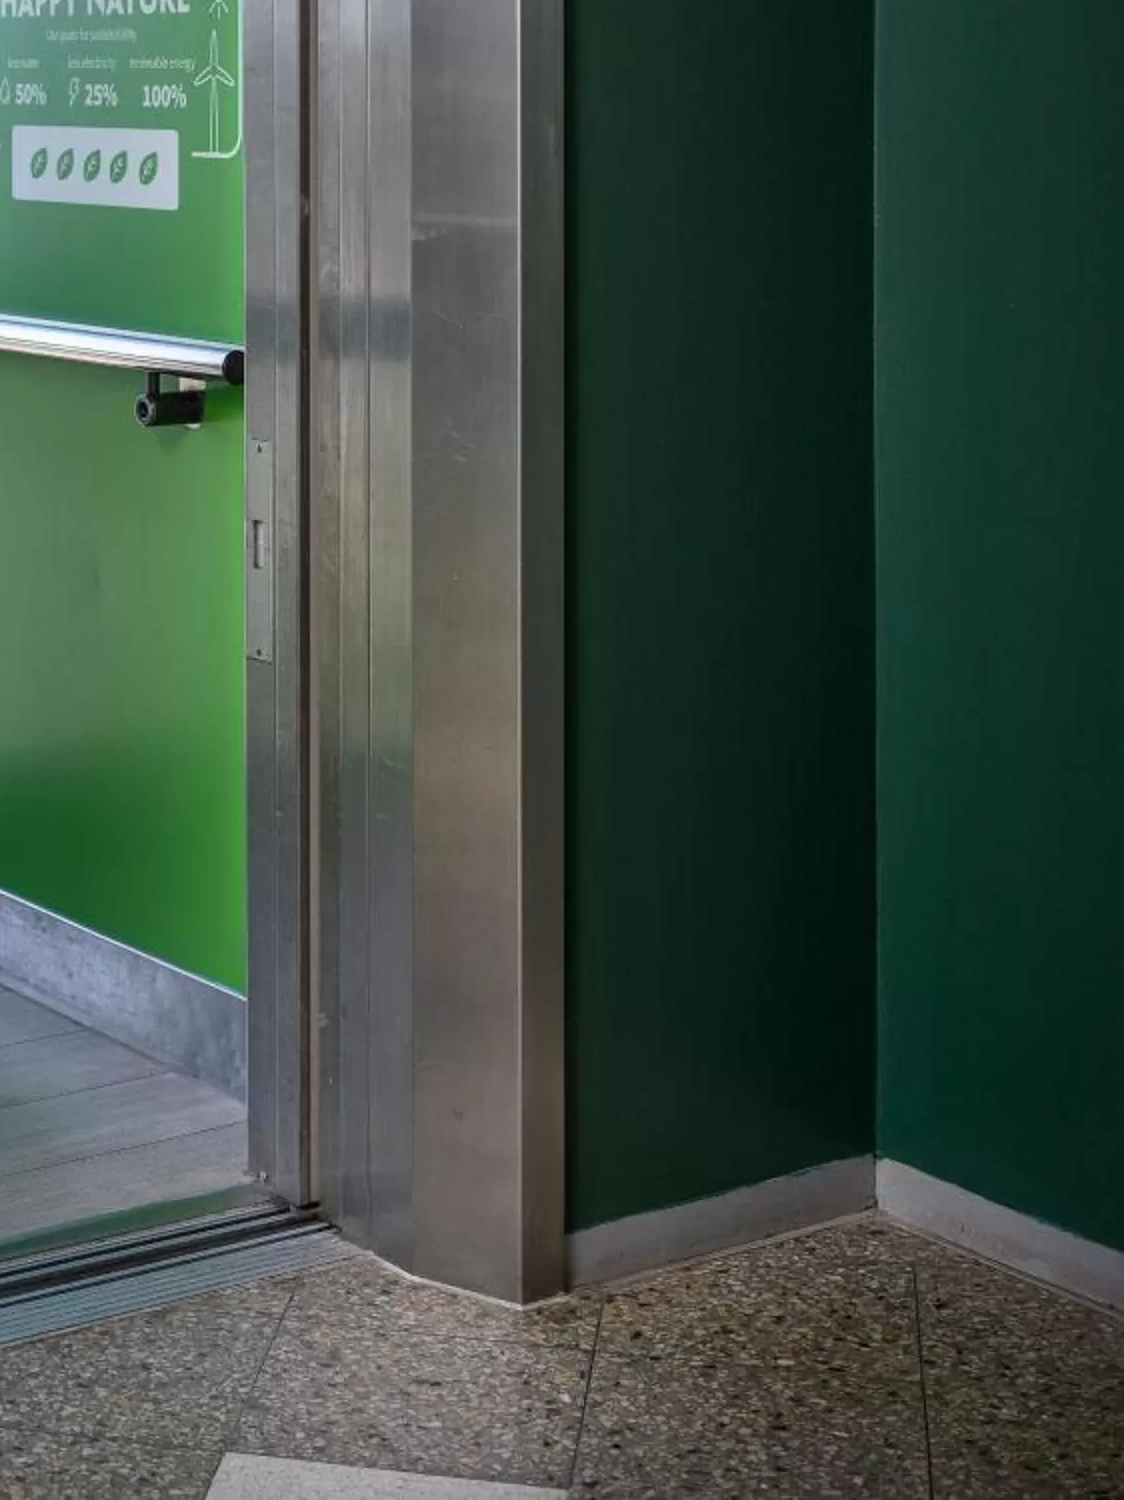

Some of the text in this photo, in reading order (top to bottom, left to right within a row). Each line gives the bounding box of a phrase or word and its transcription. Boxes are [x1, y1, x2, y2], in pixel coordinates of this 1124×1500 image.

[15, 83, 47, 106] 50%
[84, 83, 118, 107] 25%
[142, 83, 187, 108] 100%
